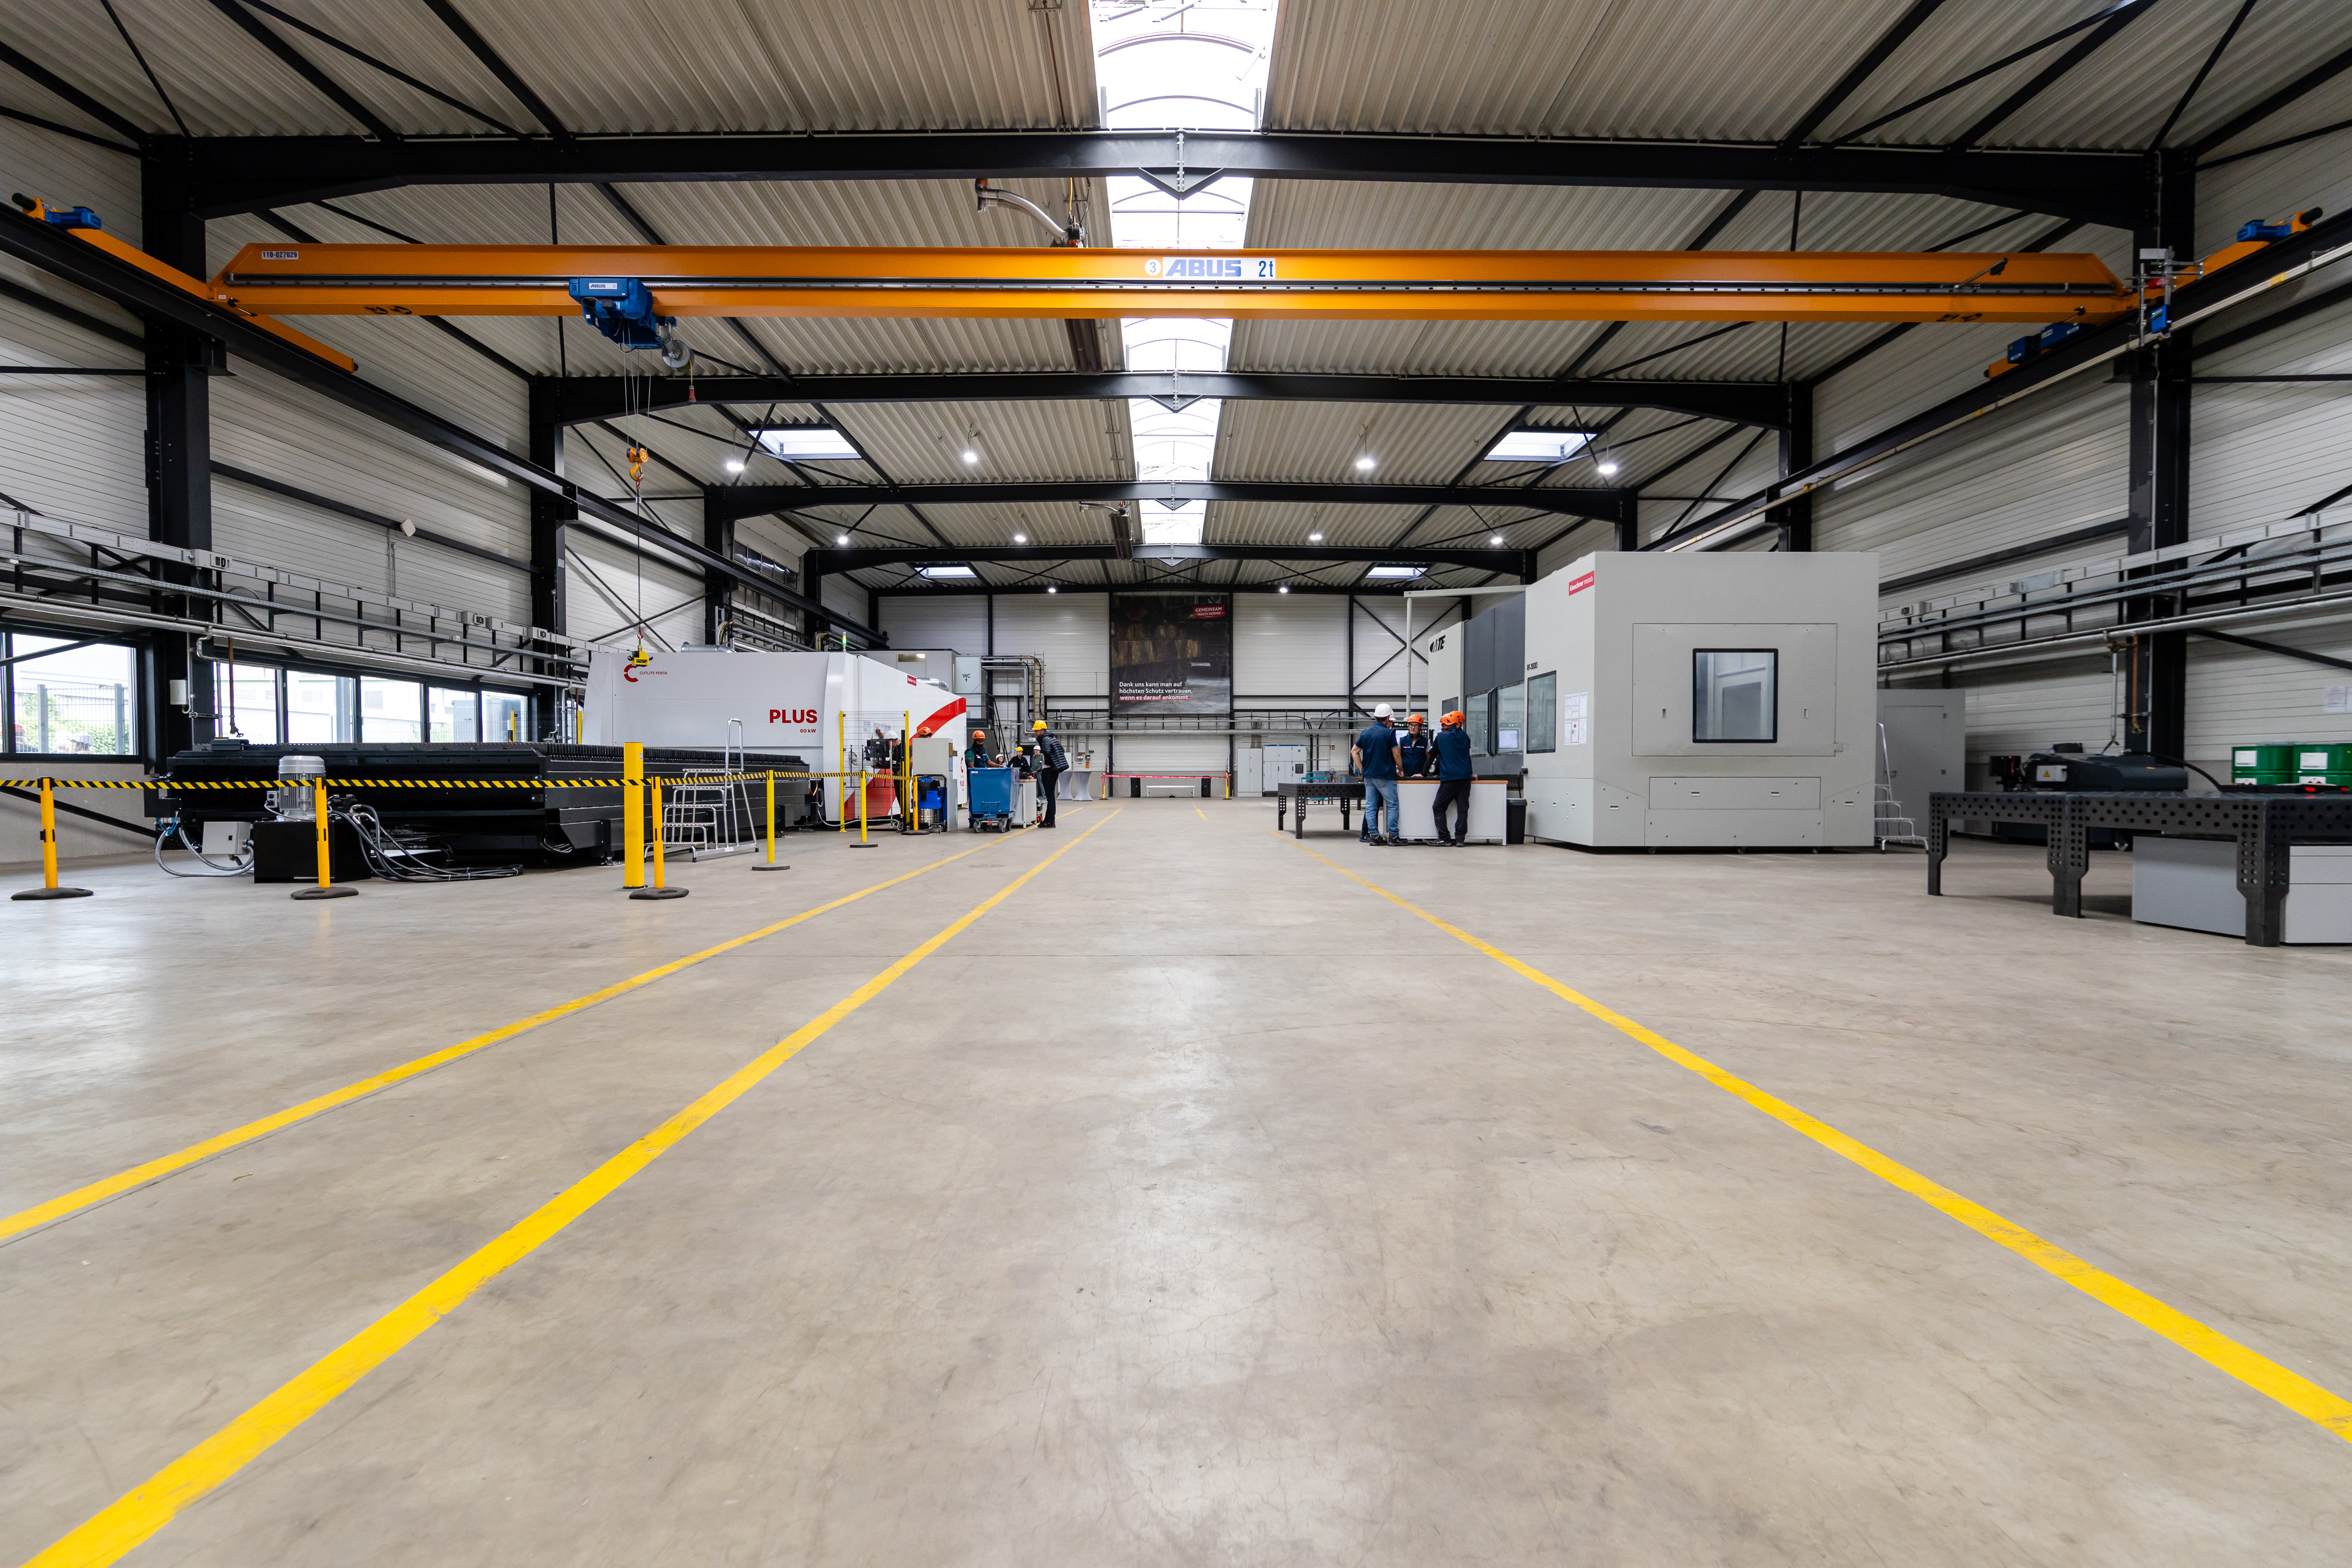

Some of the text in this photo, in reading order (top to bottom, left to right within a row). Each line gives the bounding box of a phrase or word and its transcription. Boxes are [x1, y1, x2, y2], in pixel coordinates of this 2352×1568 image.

[1150, 262, 1157, 273] 3
[1165, 259, 1241, 277] ABUS
[769, 709, 818, 724] PLUS
